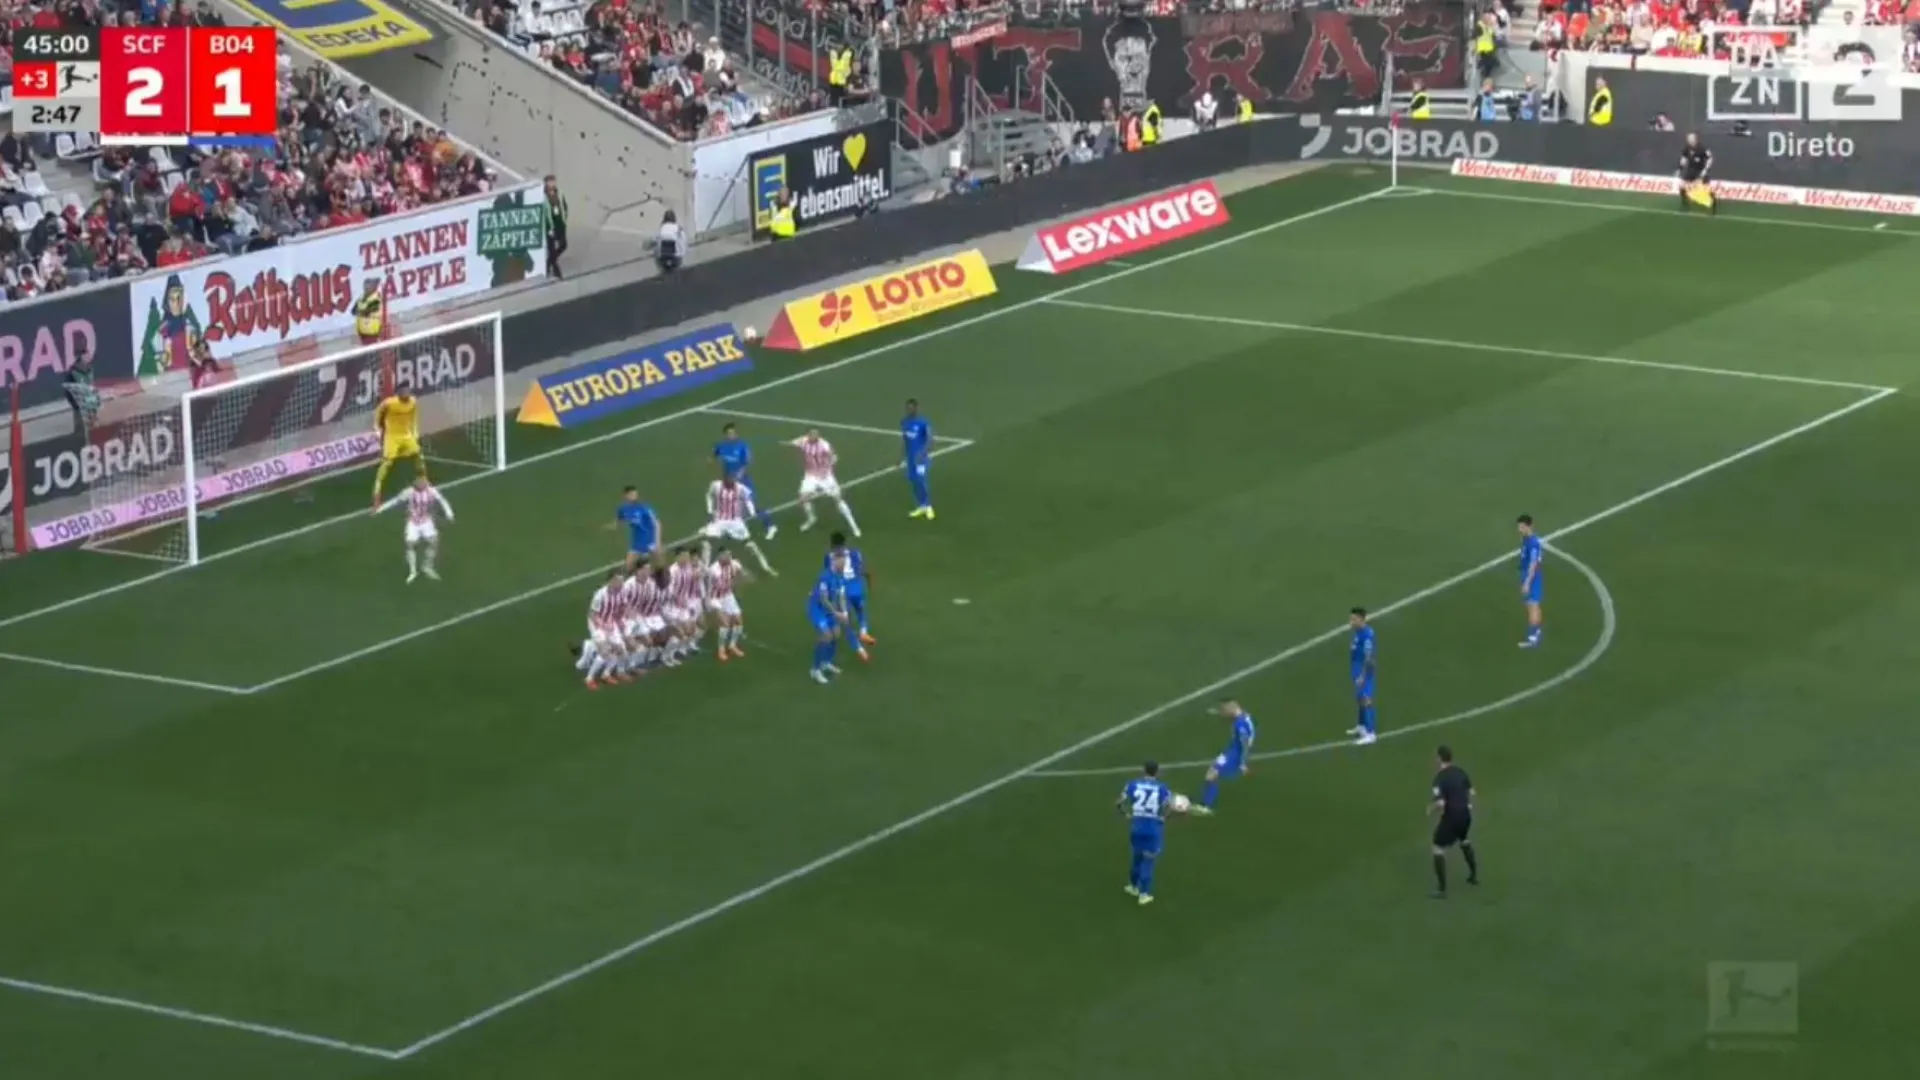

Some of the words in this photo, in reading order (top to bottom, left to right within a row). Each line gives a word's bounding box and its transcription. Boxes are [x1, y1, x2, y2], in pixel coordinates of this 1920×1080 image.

[306, 20, 411, 48] EDEKA
[812, 145, 841, 179] Wir
[1342, 126, 1499, 158] JOBRAD
[793, 167, 890, 219] ebensmittel.
[1458, 159, 1558, 182] WeberHaus
[1570, 168, 1673, 192] WeberHaus
[1803, 188, 1916, 213] WeberHaus
[480, 204, 542, 230] TANNEN
[480, 225, 541, 249] ZÄPFLE
[1043, 188, 1218, 262] Lexware
[359, 219, 469, 271] TANNEN
[203, 263, 353, 341] Rothaus
[374, 256, 467, 300] ÄPFLE
[864, 261, 966, 312] LOTTO
[546, 358, 667, 412] EUROPA
[663, 334, 744, 376] PARK
[32, 426, 174, 496] JOBRAD
[46, 508, 117, 543] JOBRAD
[223, 459, 288, 491] JOBRAD
[304, 437, 369, 467] JOBRAD
[1132, 788, 1159, 812] 24
